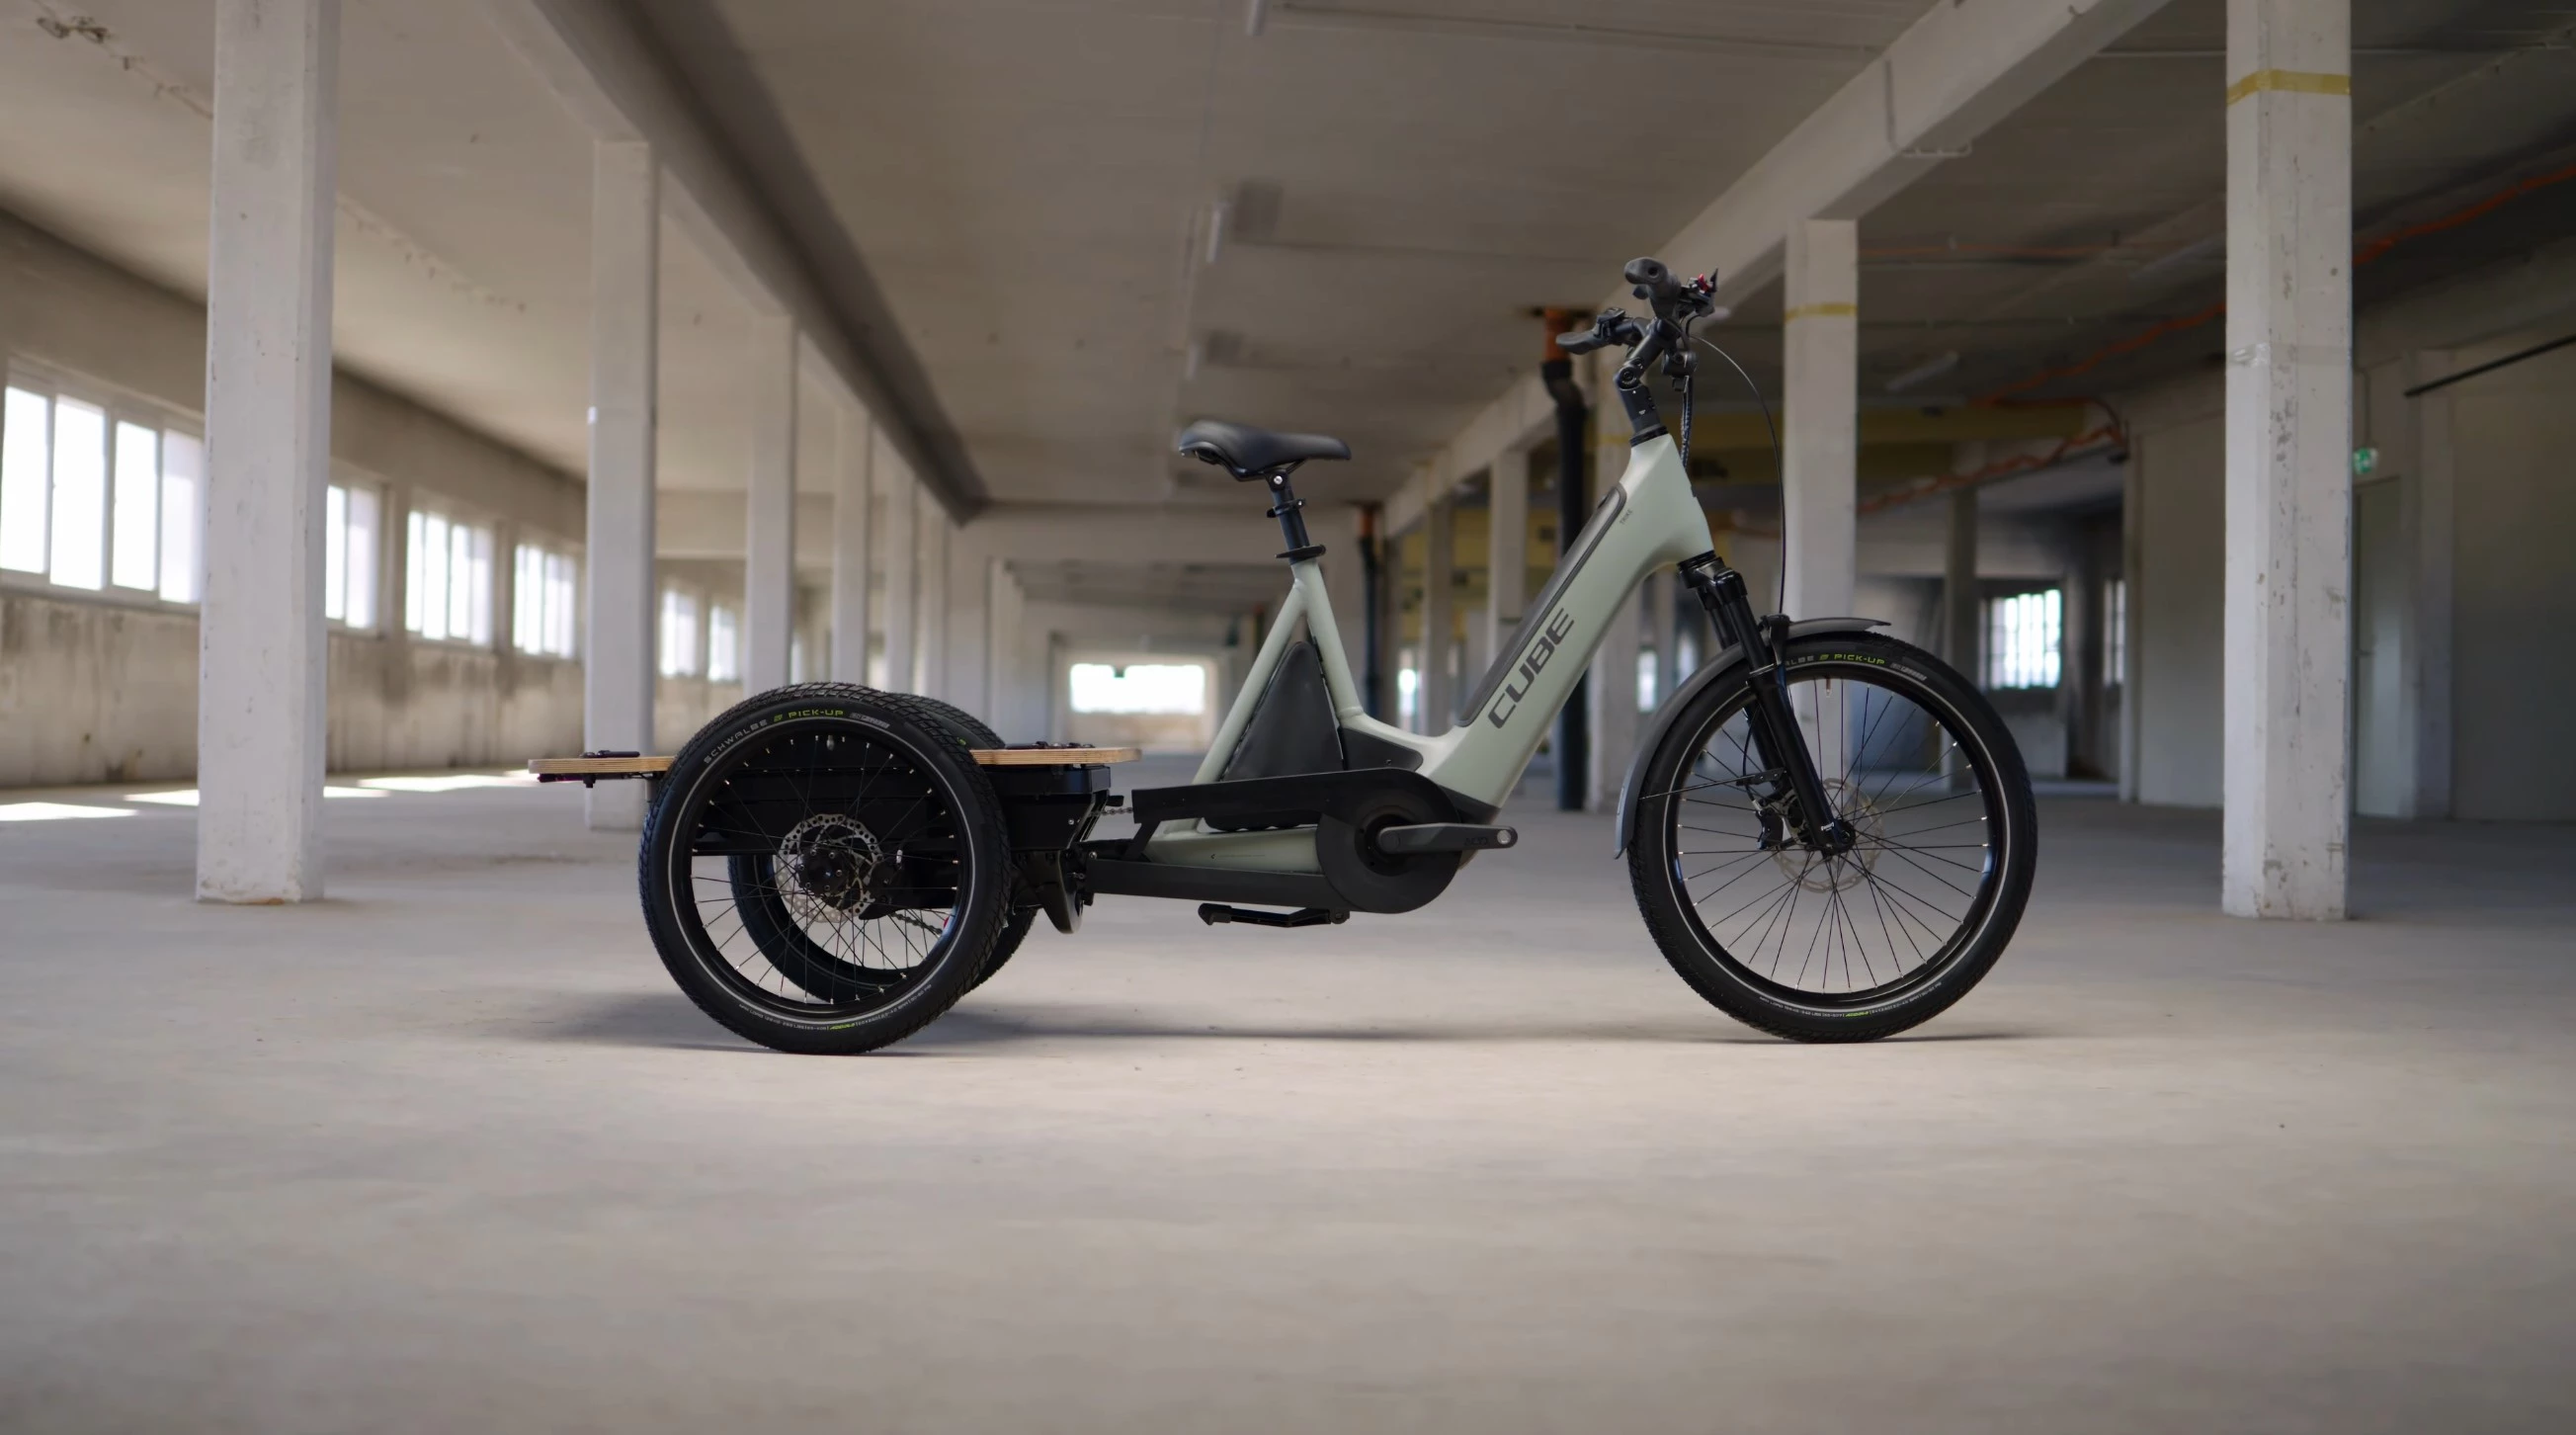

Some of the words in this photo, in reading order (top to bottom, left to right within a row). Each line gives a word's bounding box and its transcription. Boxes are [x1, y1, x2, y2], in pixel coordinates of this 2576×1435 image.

[1487, 608, 1575, 729] CUBE
[1834, 653, 1885, 665] PICK-UP
[704, 718, 768, 764] SCHWALBE
[788, 709, 844, 718] PICK-UP
